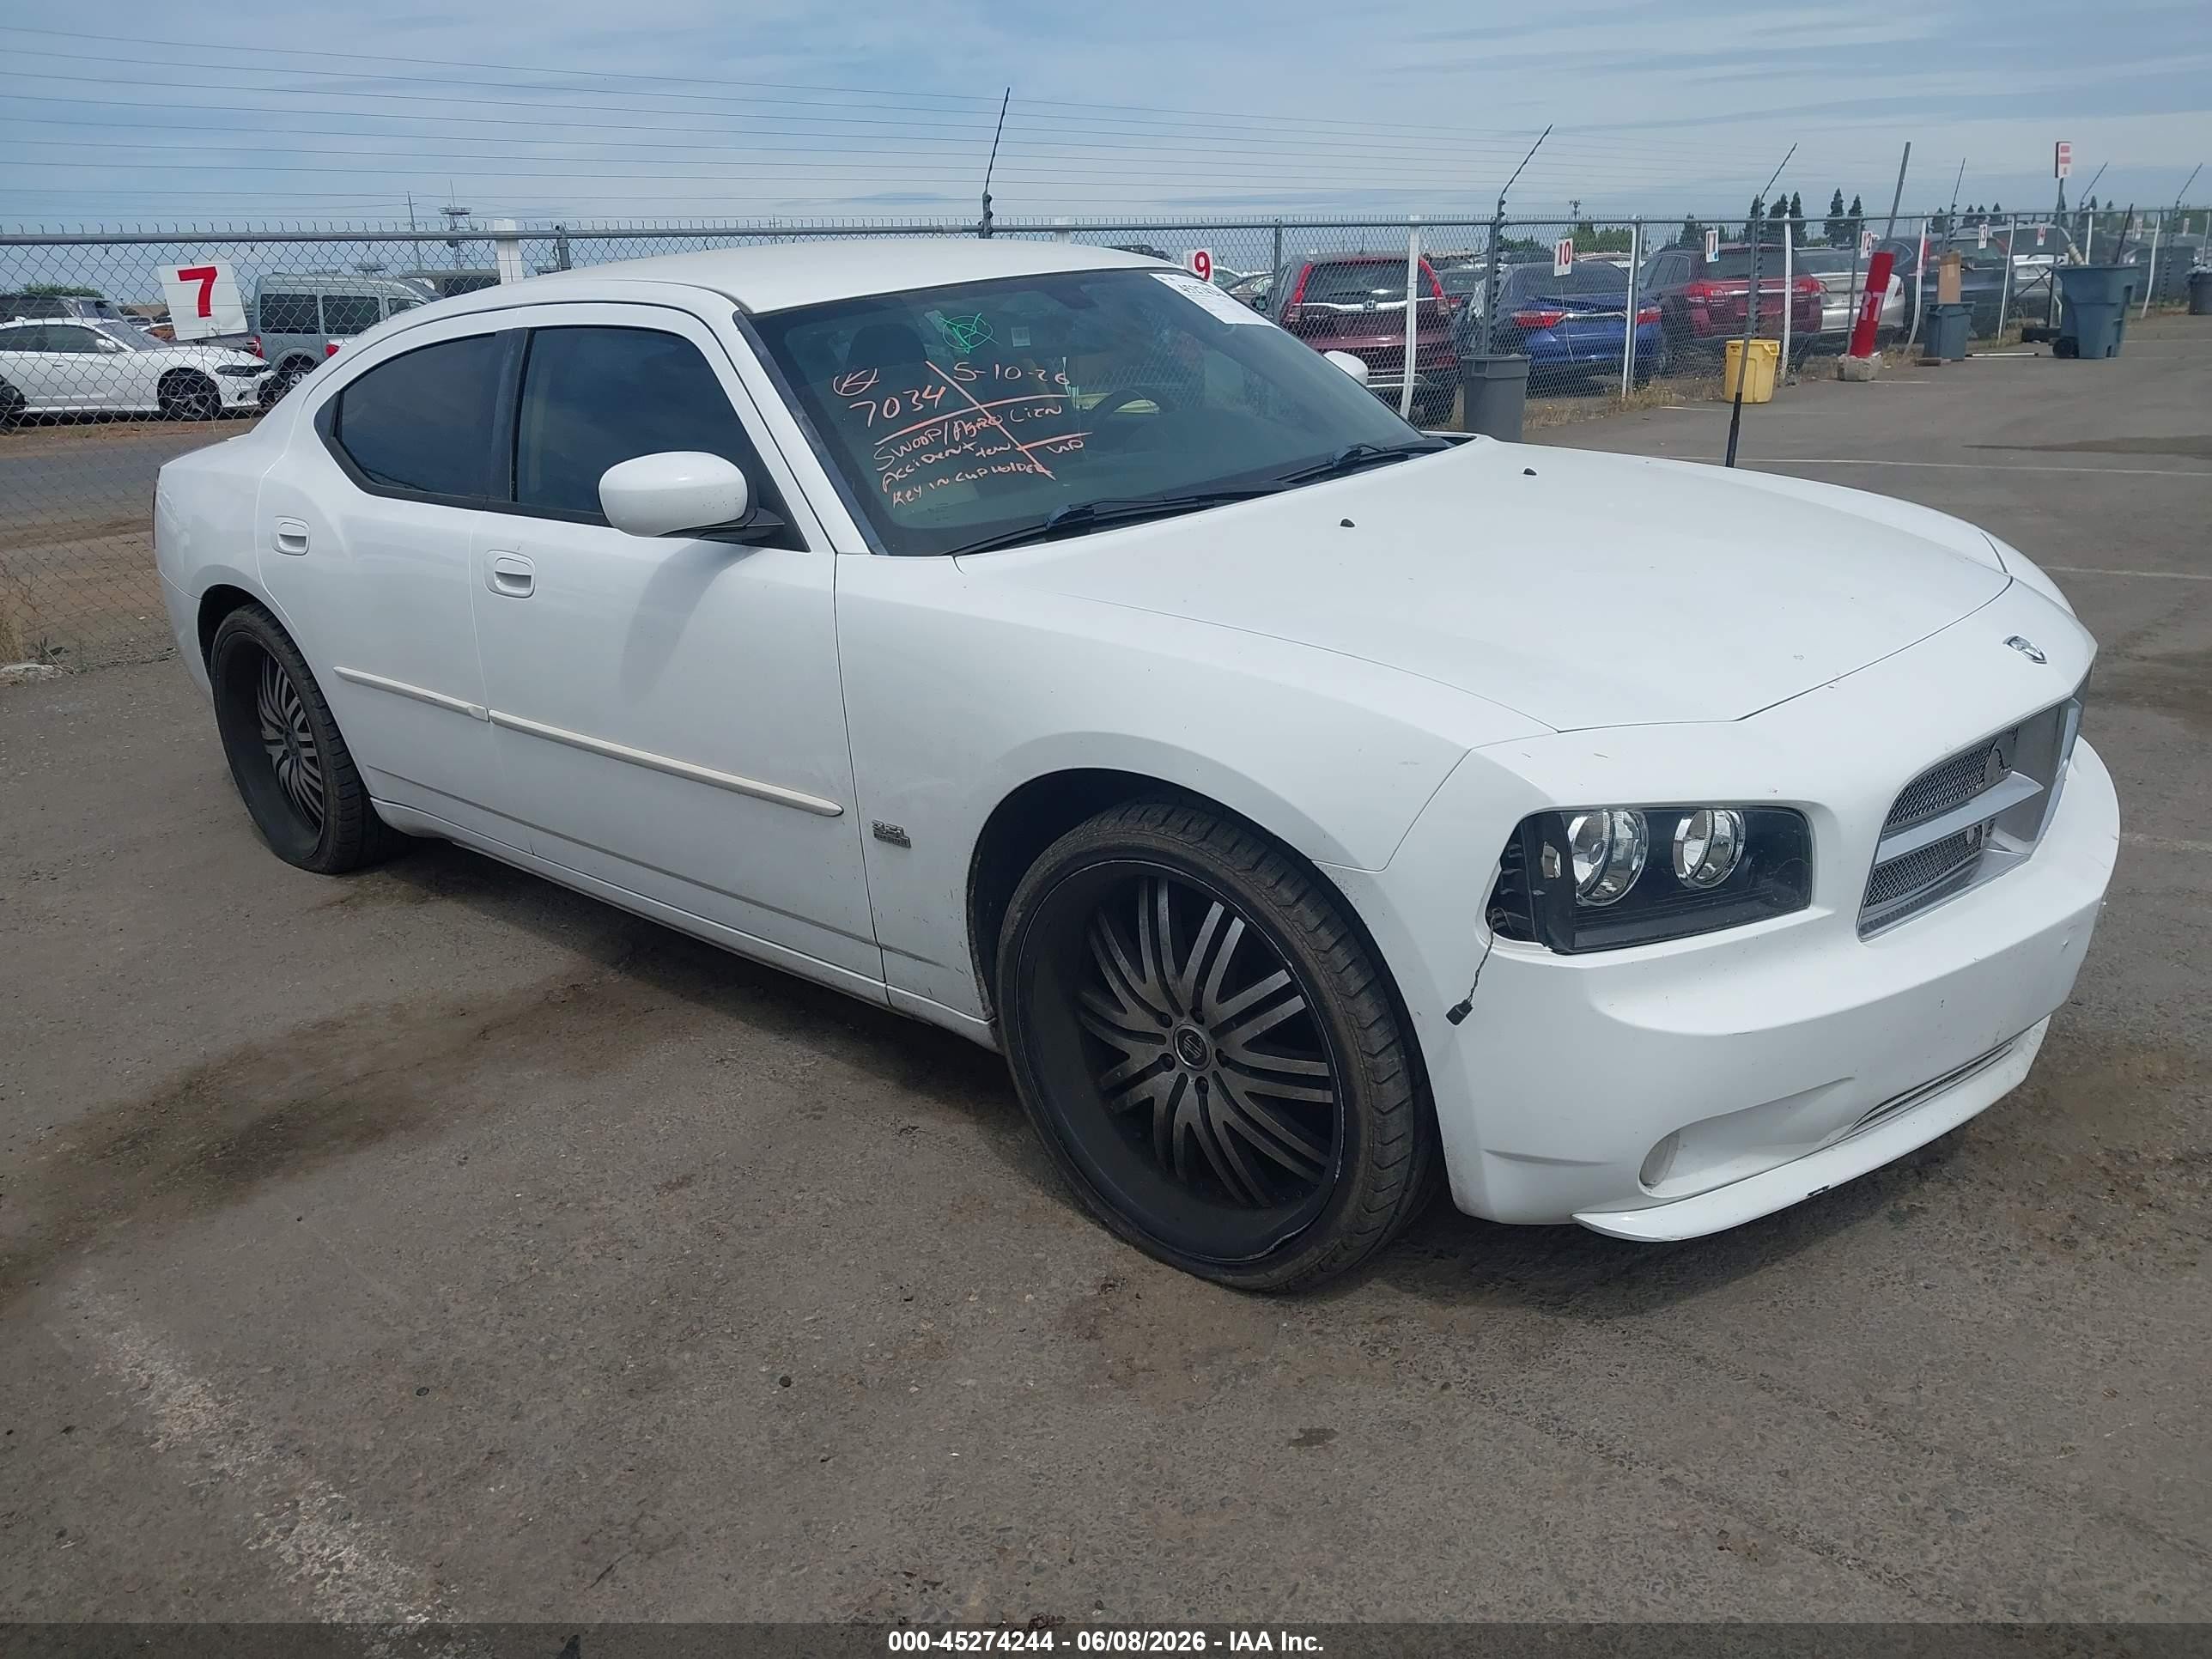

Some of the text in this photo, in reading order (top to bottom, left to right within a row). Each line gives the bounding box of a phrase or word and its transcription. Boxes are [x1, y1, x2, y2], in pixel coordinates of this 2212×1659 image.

[1194, 251, 1211, 282] 9
[1559, 240, 1571, 266] 10
[178, 266, 217, 318] 7
[953, 361, 1071, 386] 5-10-26
[848, 384, 947, 428] 7034
